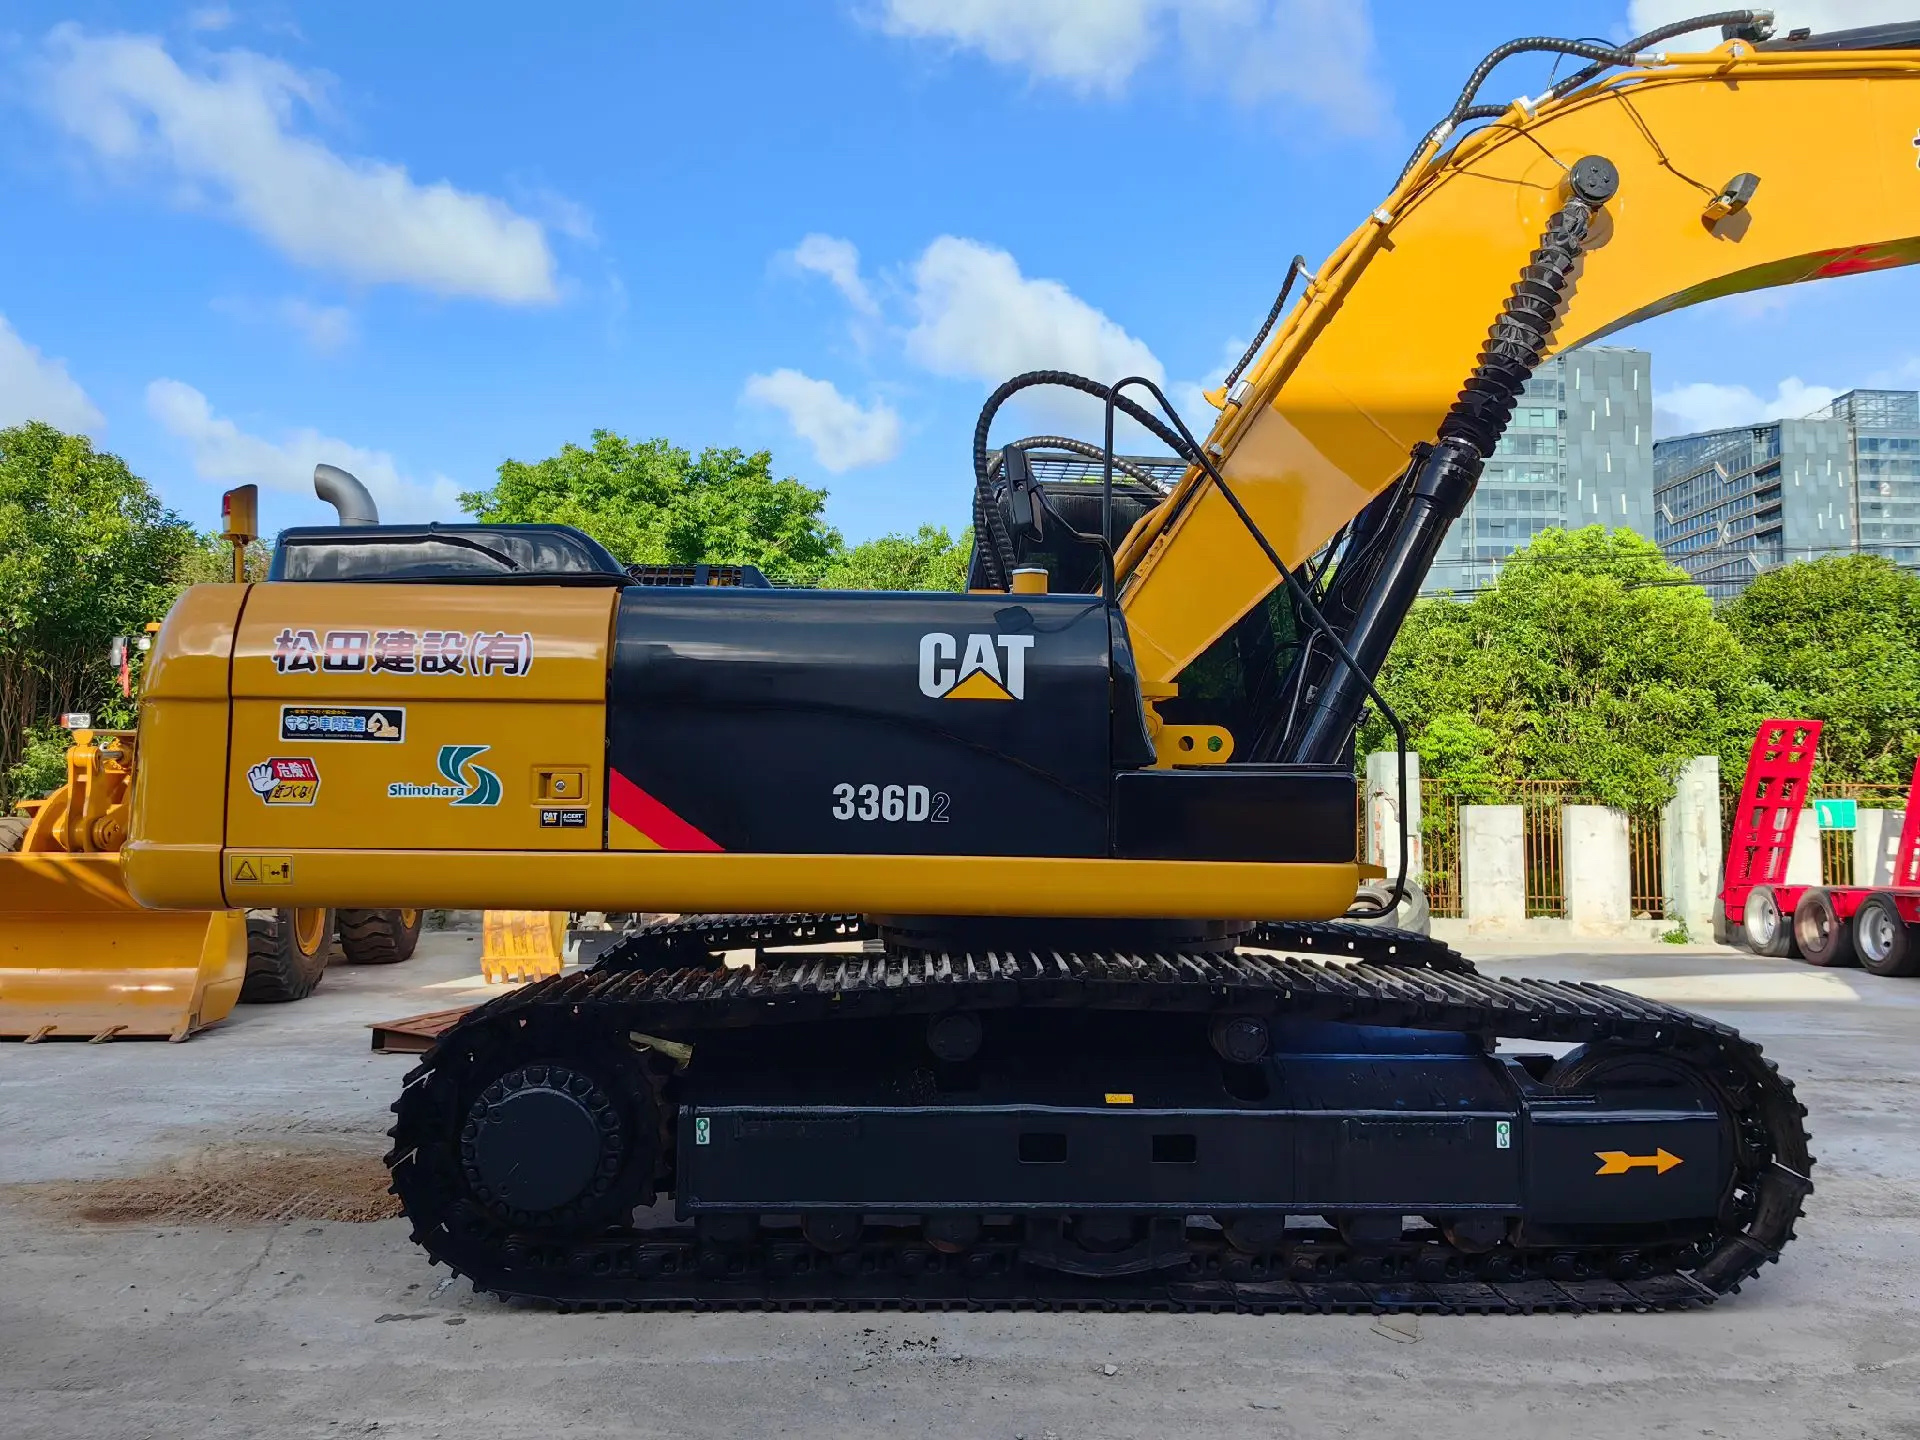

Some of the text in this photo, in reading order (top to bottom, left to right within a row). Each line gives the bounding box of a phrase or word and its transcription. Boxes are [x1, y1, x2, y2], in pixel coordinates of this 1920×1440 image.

[273, 628, 533, 676] 松田建設(有)
[919, 632, 1035, 700] CAT
[285, 715, 366, 731] 守ろう車間距離
[388, 784, 466, 797] Shinohara
[832, 783, 951, 823] 336D2
[543, 812, 558, 821] CAT
